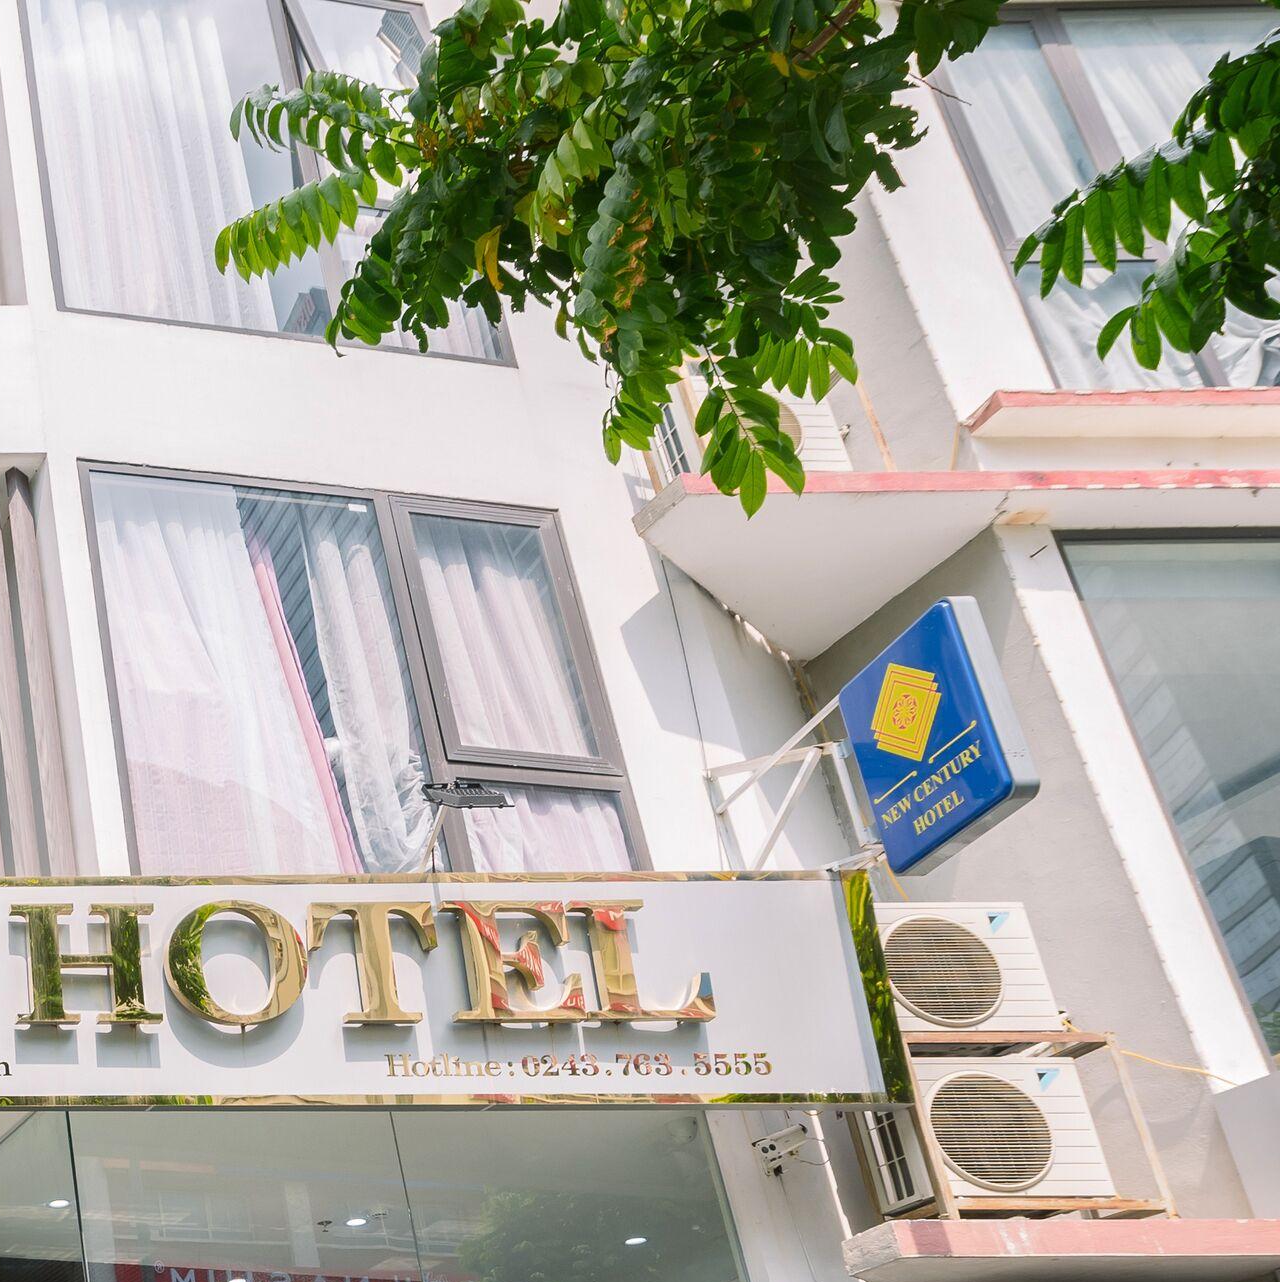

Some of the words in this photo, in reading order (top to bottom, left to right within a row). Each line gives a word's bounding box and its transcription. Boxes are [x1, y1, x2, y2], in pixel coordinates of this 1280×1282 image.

[881, 794, 912, 829] NEW
[912, 740, 983, 803] CENTURY
[913, 790, 965, 835] HOTEL
[8, 898, 717, 1028] HOTEL
